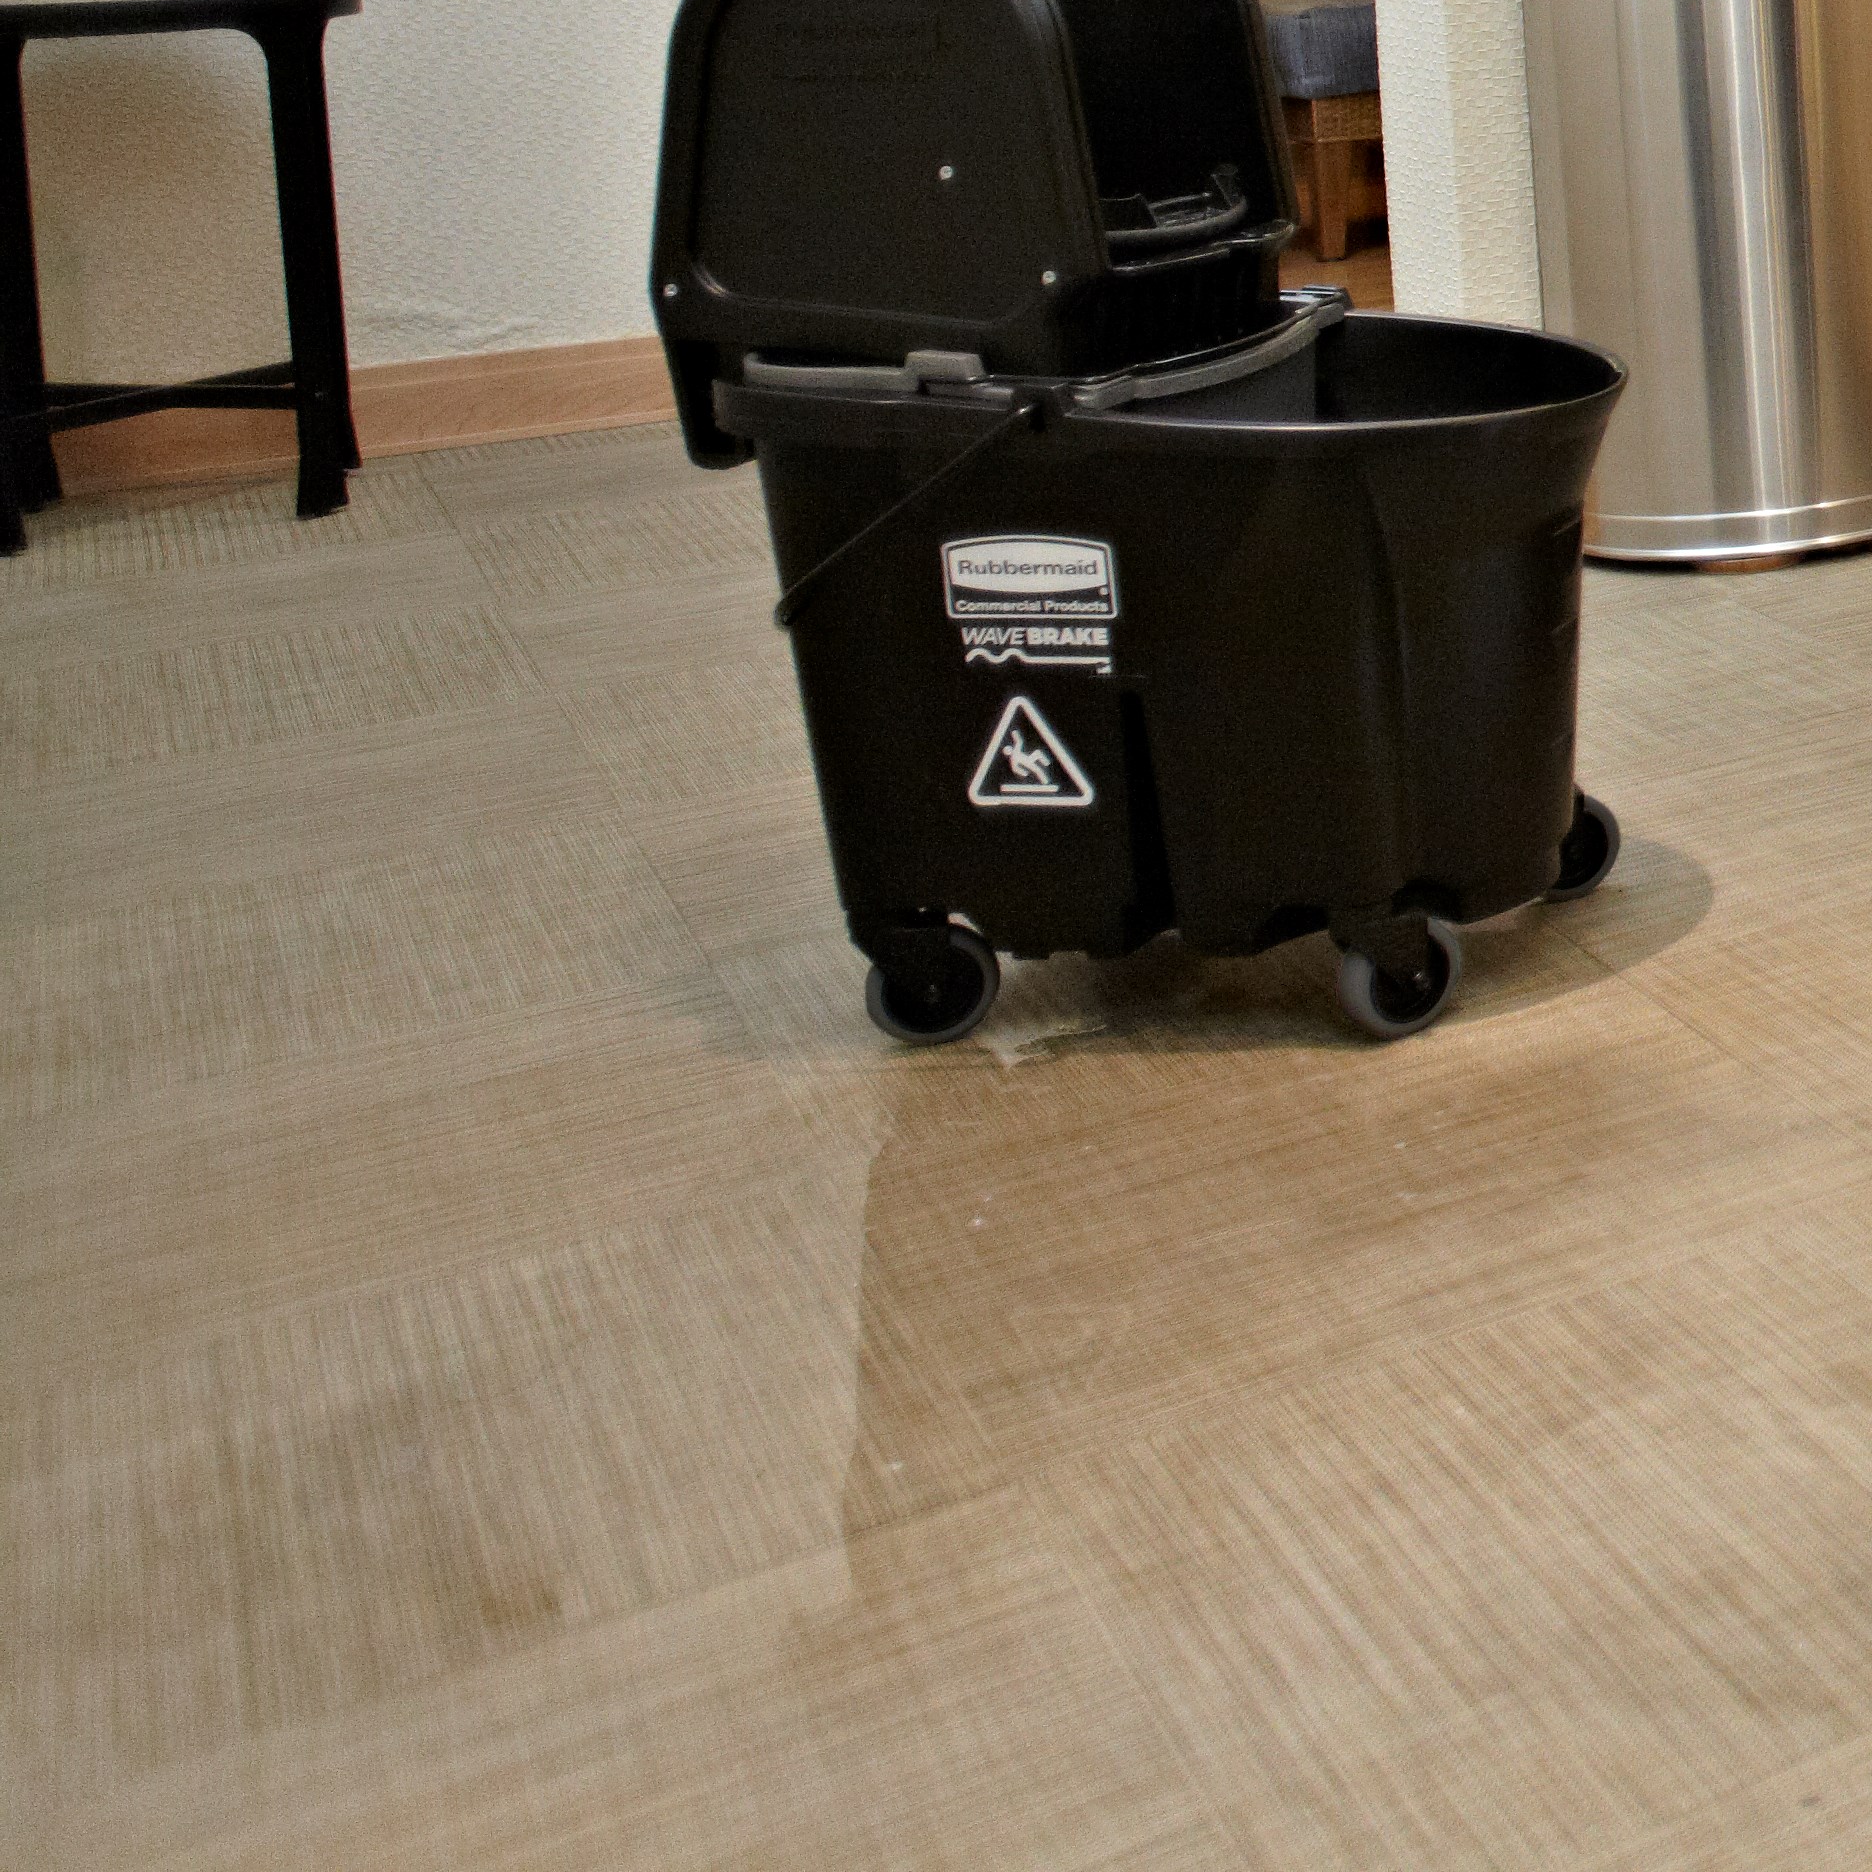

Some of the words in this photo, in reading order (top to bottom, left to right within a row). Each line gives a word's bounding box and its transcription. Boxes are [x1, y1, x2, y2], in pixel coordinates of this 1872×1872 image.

[957, 559, 1099, 576] Rubbermaid
[955, 599, 1042, 612] Commercial
[1044, 599, 1109, 612] Products
